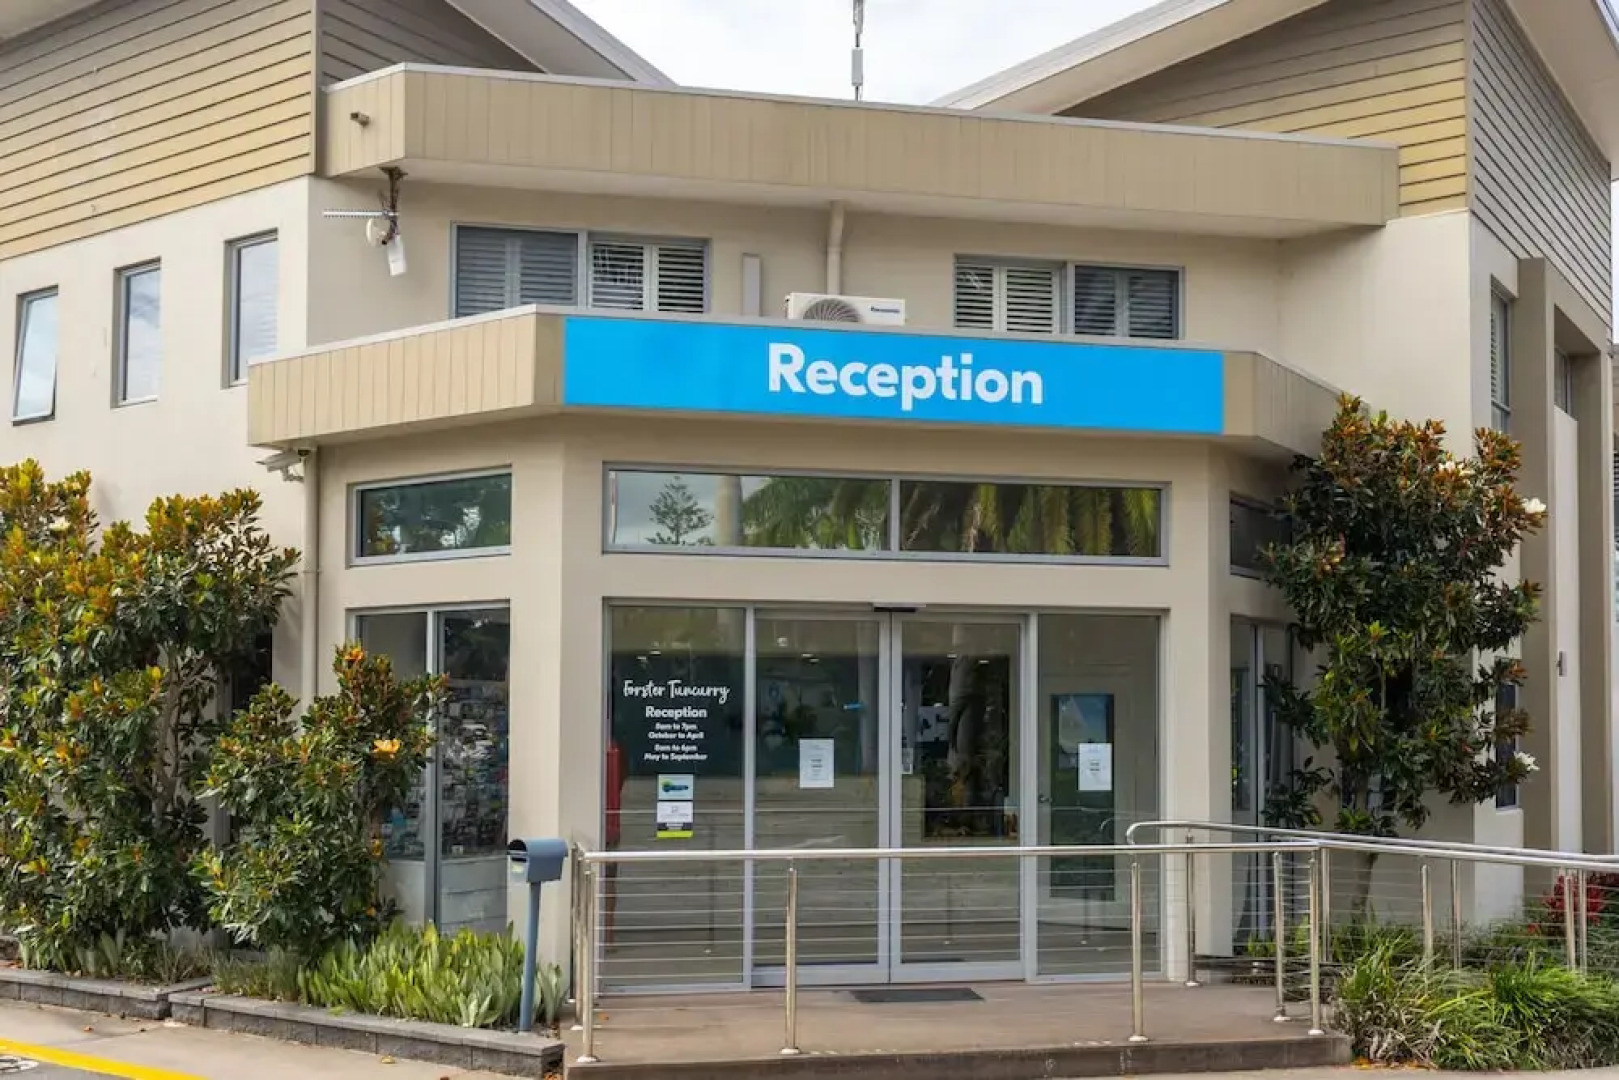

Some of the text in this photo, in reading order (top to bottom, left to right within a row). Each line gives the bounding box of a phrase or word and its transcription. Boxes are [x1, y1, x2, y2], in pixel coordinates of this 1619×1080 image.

[768, 342, 1044, 411] Reception
[623, 680, 730, 704] Forster Tuncurry
[645, 705, 708, 720] Reception
[687, 732, 704, 740] April
[672, 744, 680, 752] to
[644, 753, 660, 761] May
[670, 753, 707, 761] September
